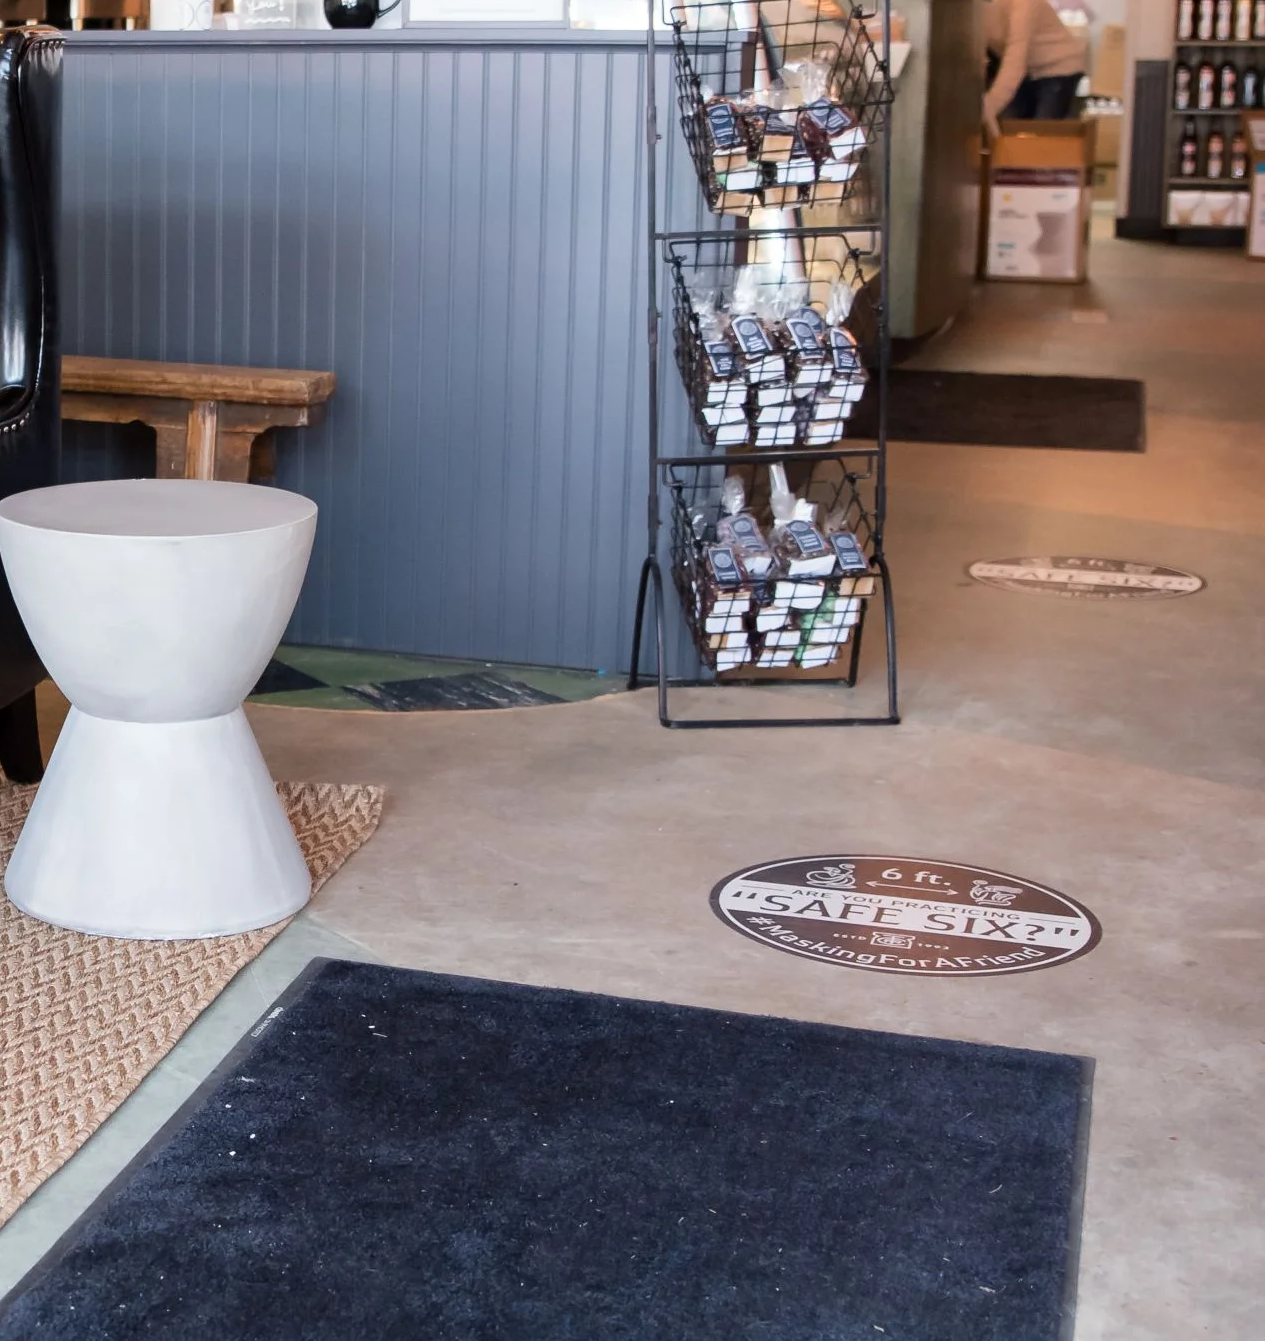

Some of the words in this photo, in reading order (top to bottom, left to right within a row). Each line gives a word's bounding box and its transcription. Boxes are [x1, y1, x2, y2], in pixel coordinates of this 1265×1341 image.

[880, 867, 900, 882] 6
[912, 869, 952, 887] ft.
[791, 888, 833, 900] ARE
[839, 893, 883, 906] YOU
[891, 899, 1021, 922] PRACTICING
[746, 914, 1045, 971] #MaskingForAFriend
